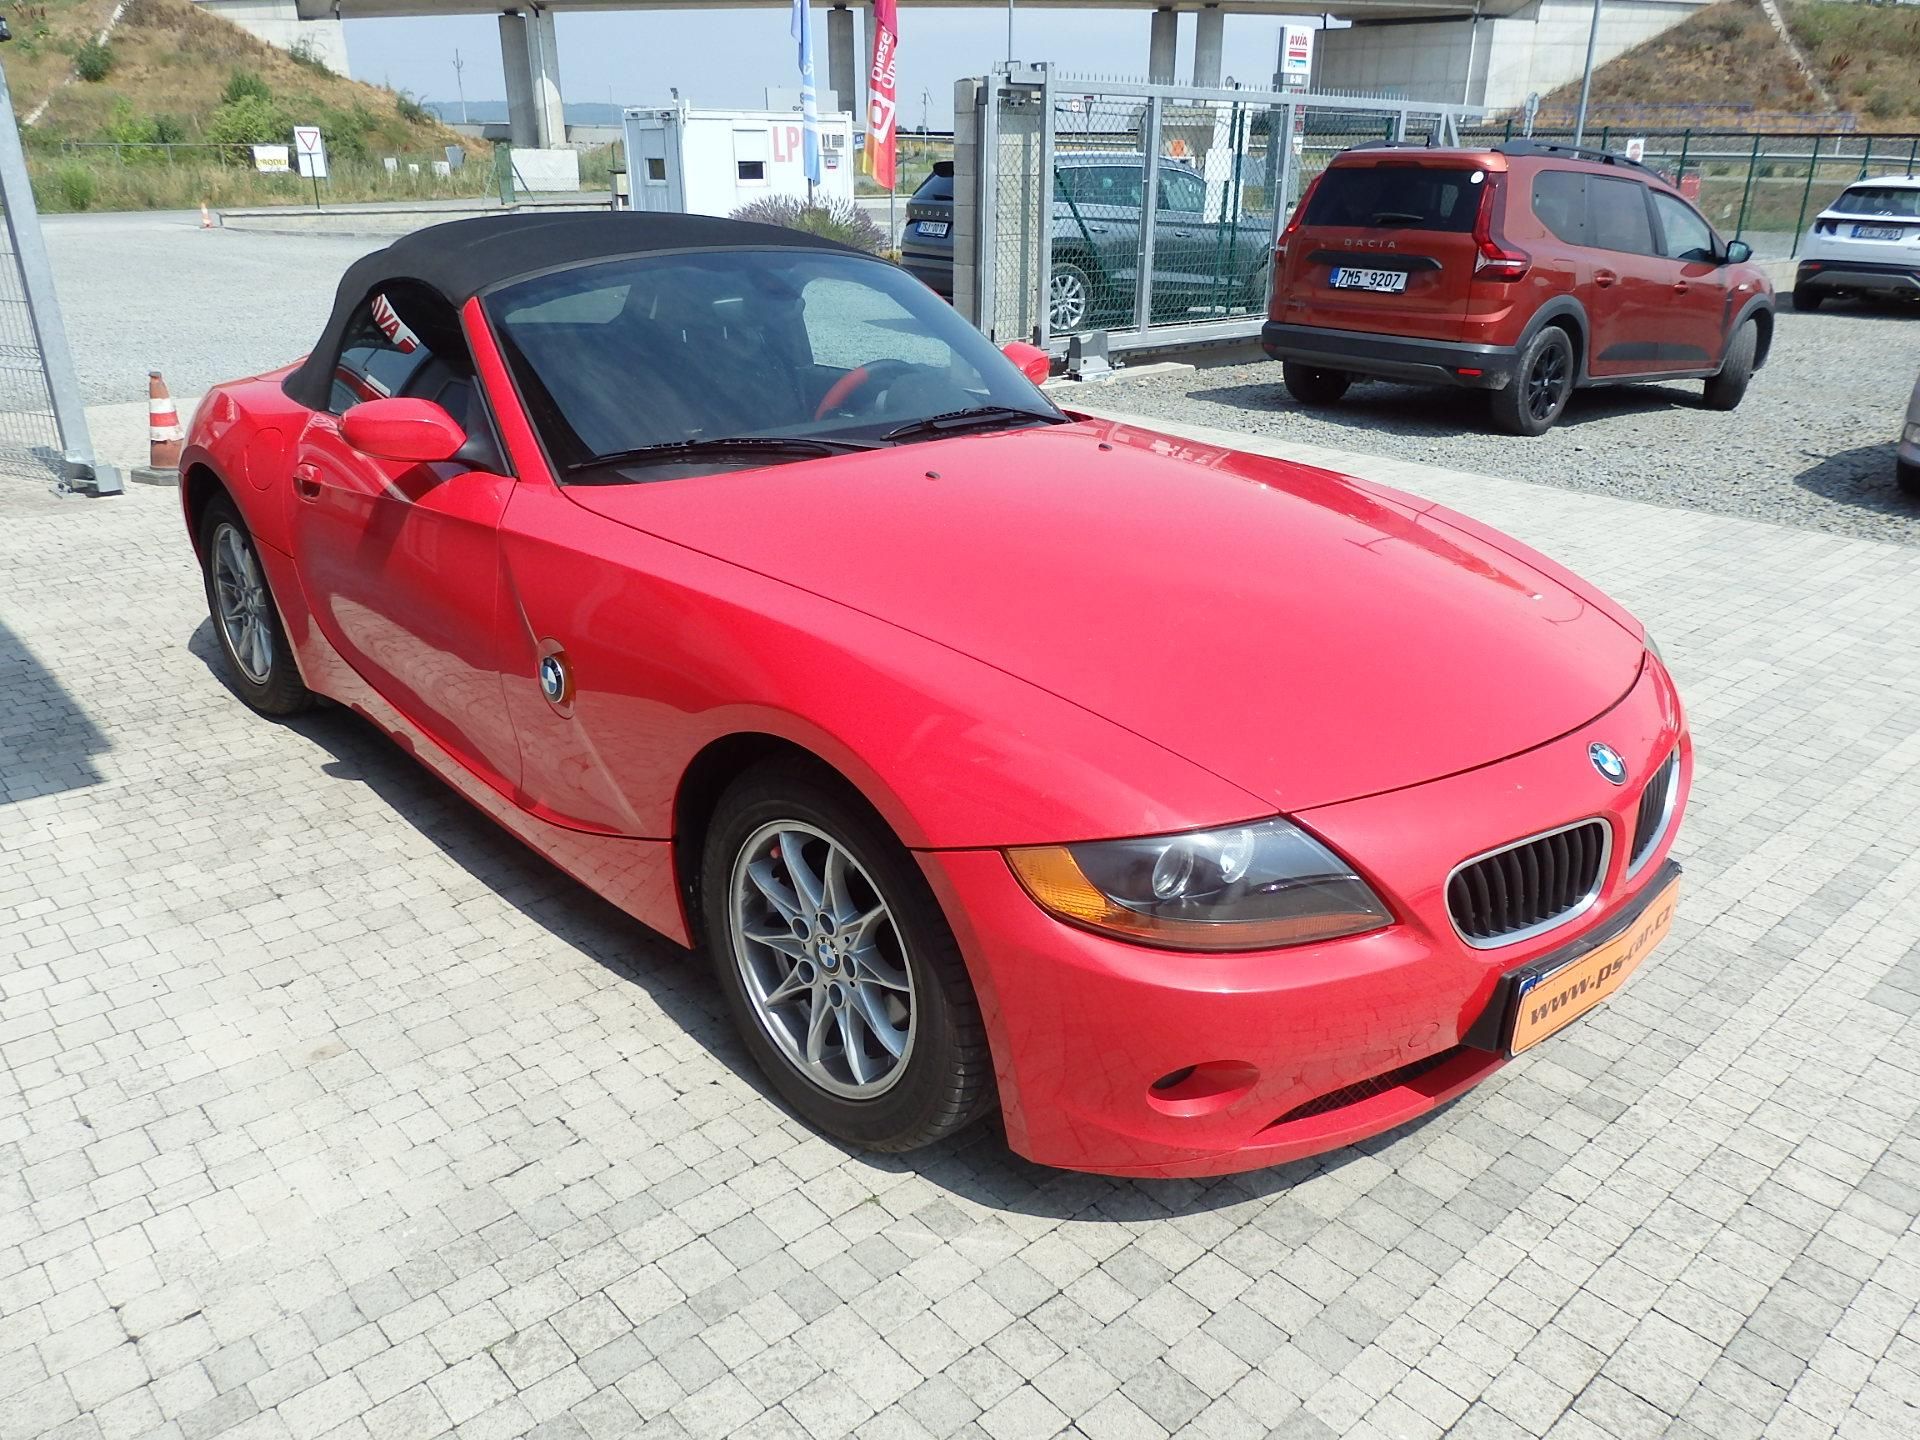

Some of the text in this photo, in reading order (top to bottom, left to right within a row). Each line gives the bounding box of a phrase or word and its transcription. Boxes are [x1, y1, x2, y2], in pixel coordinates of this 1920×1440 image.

[1290, 33, 1308, 47] AVIA
[772, 125, 804, 163] LP
[1344, 238, 1396, 249] DACIA
[1339, 269, 1363, 285] 7M5
[1368, 272, 1401, 288] 9207
[1530, 903, 1672, 1026] www.ps-car.cz
